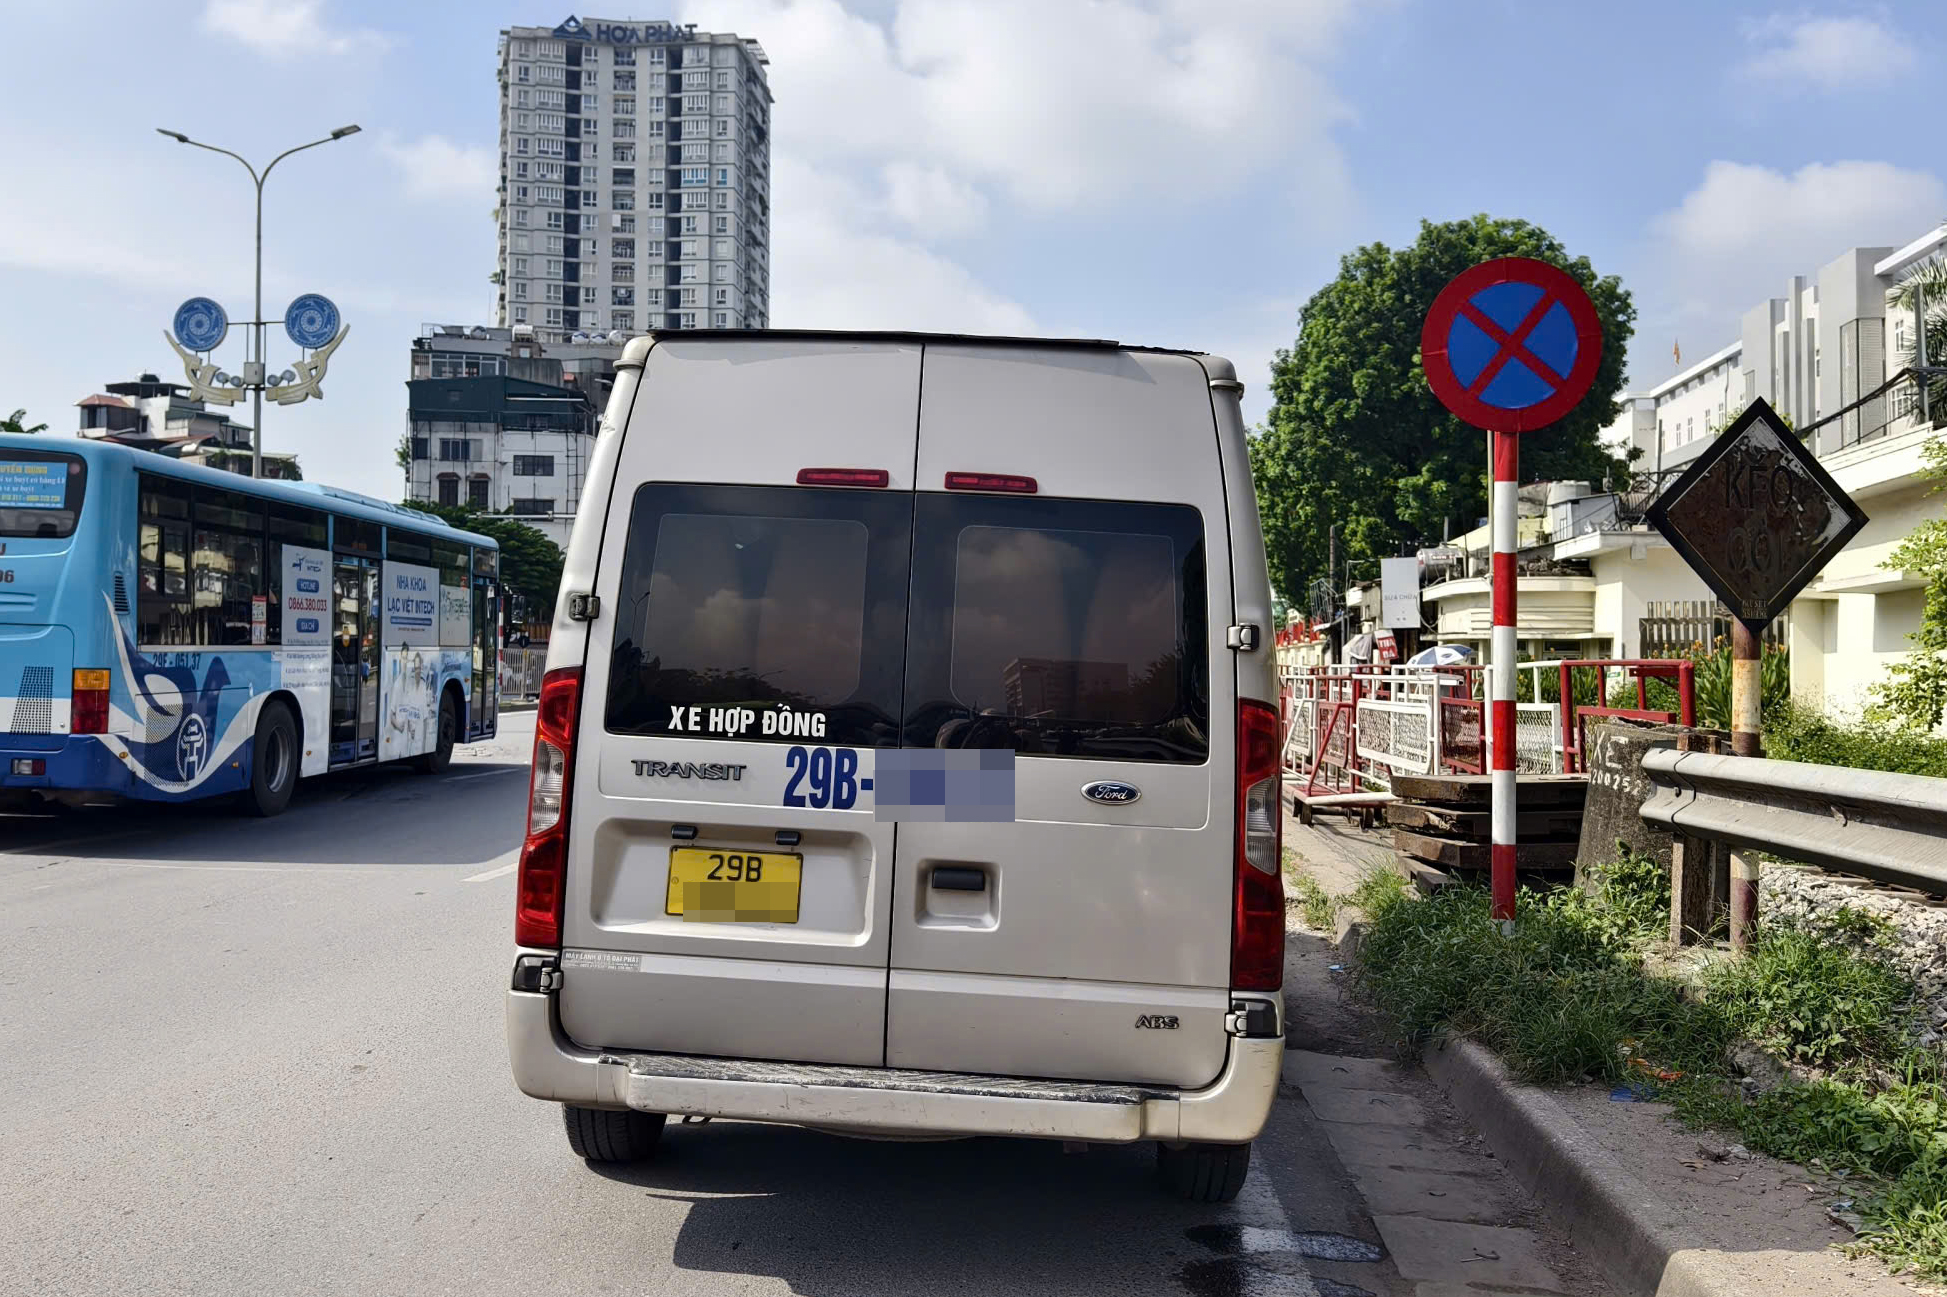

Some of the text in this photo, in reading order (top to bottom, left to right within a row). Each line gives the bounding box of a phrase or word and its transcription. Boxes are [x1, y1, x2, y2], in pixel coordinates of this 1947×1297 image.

[668, 703, 826, 738] XE HỢP ĐỒNG
[631, 759, 747, 781] TRANSIT
[1094, 785, 1127, 800] Ford
[707, 854, 763, 882] 29B
[1135, 1014, 1179, 1029] ABS
